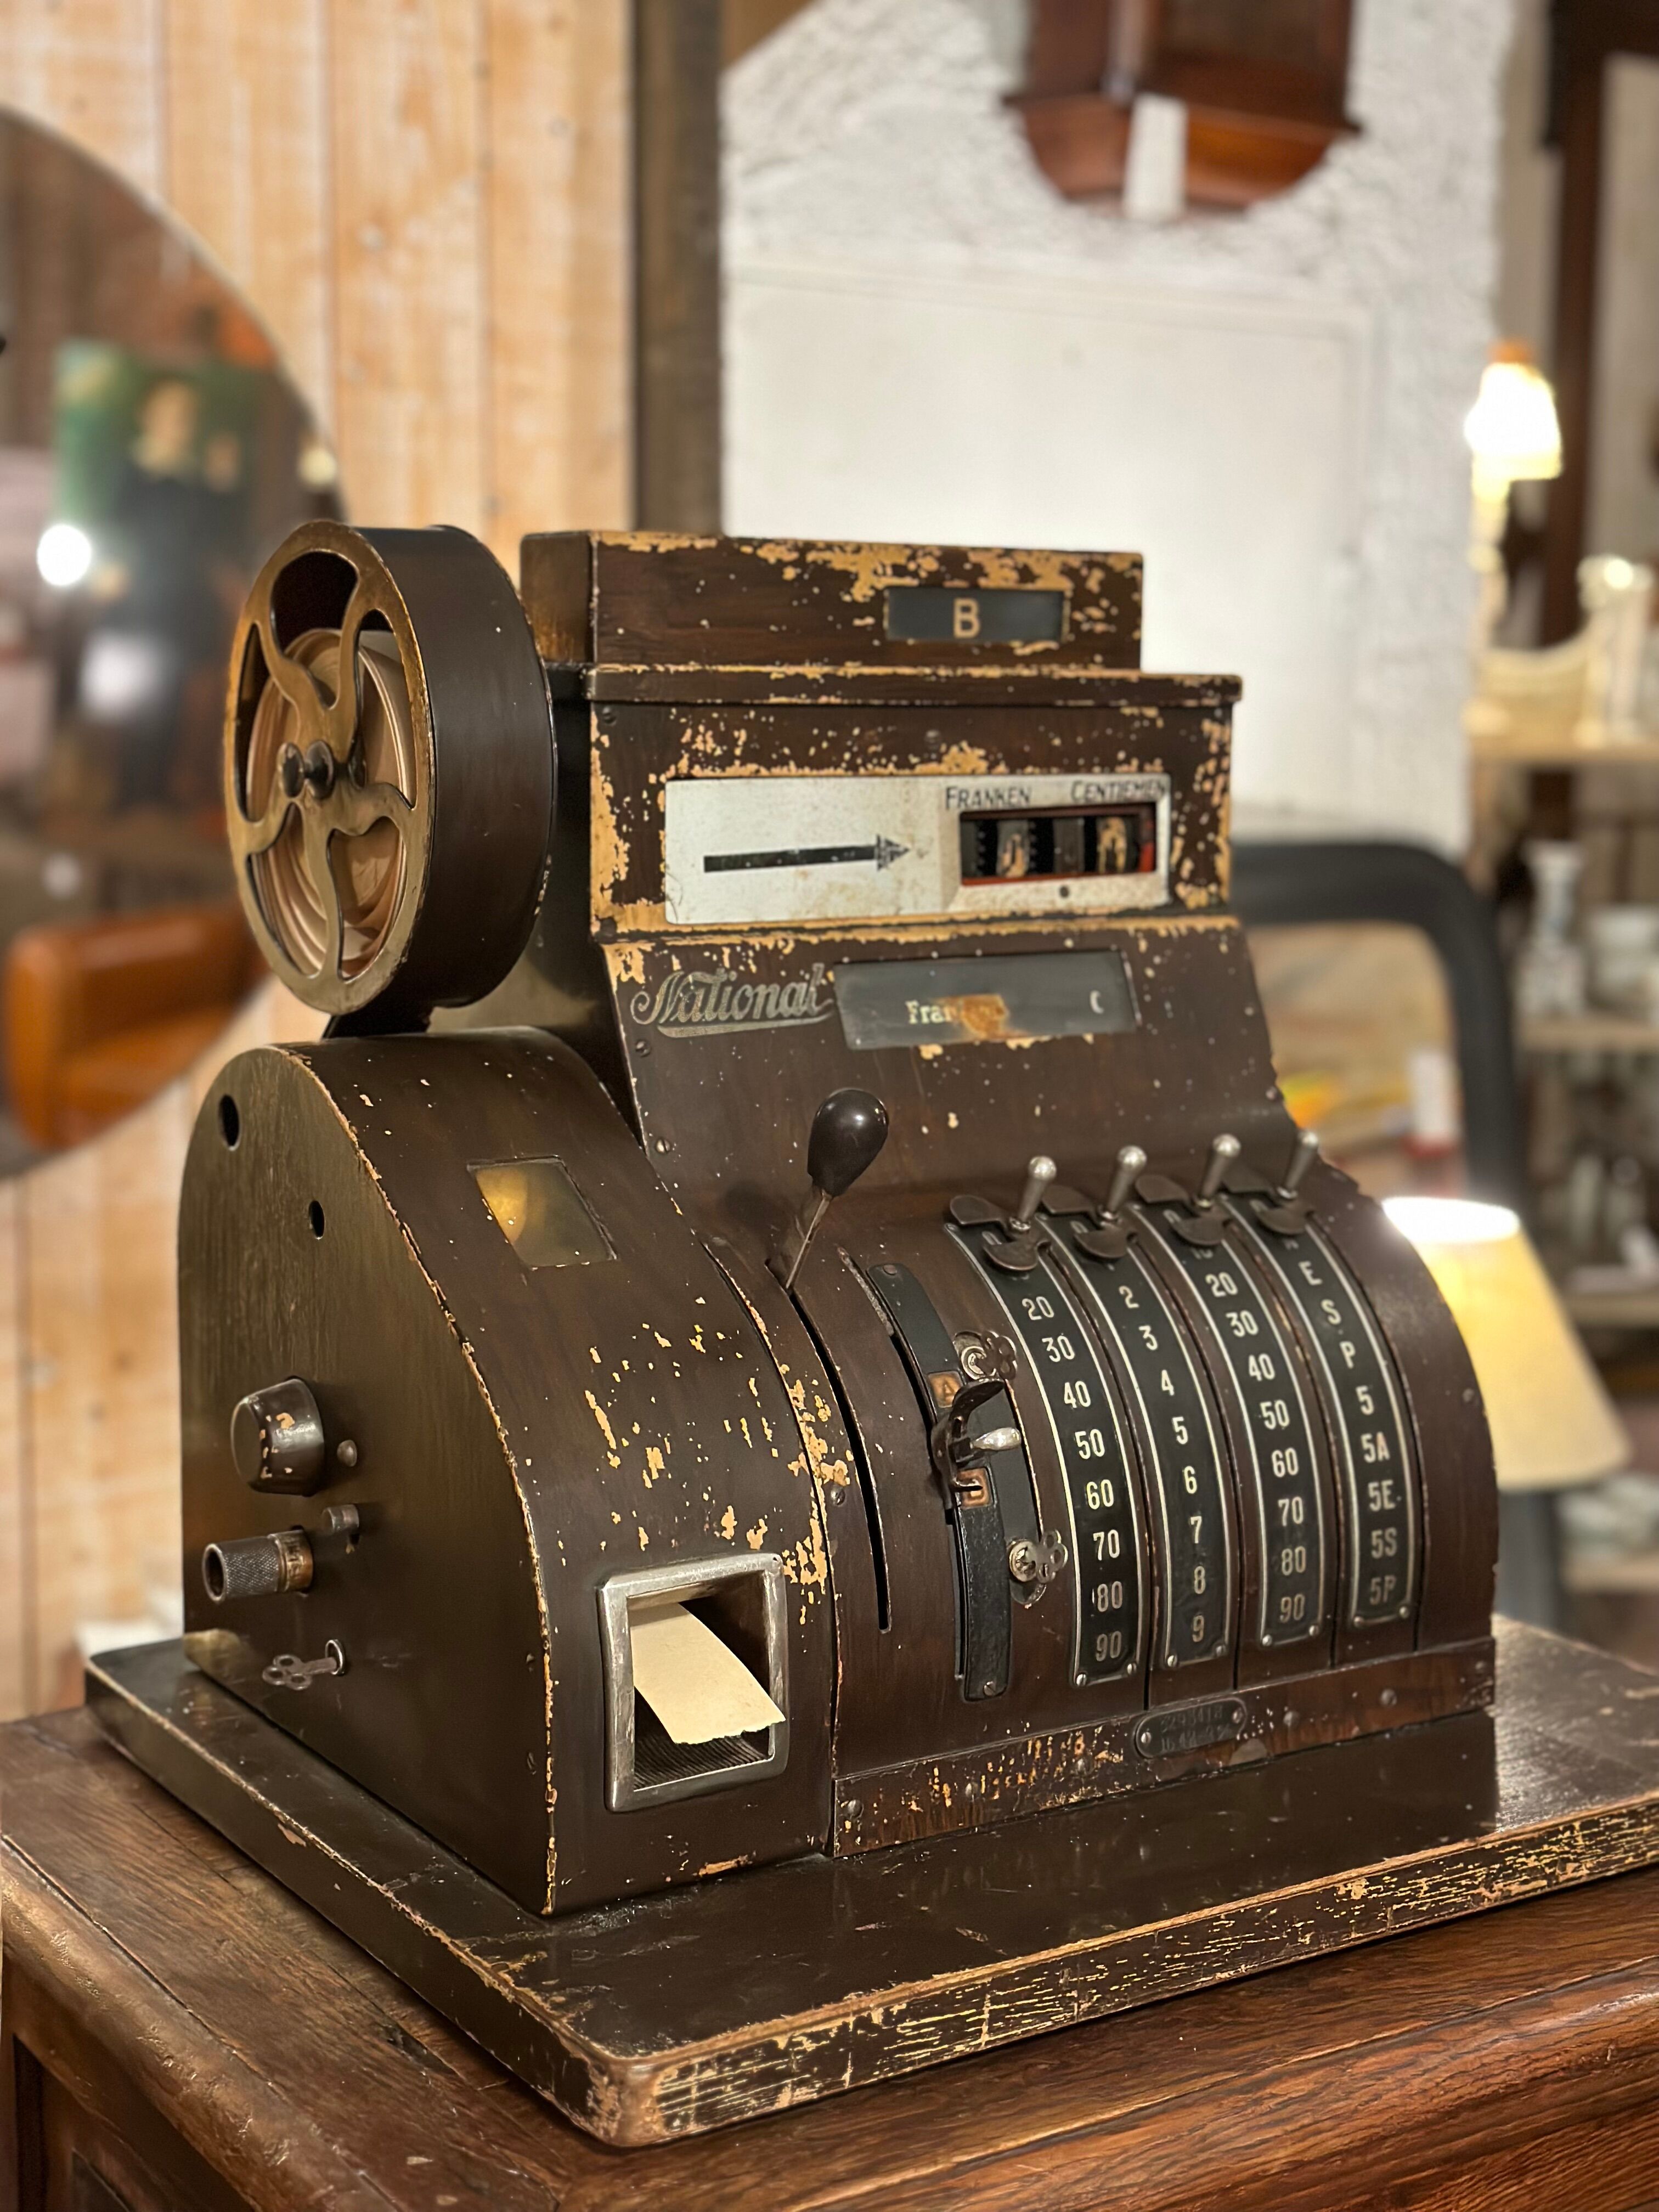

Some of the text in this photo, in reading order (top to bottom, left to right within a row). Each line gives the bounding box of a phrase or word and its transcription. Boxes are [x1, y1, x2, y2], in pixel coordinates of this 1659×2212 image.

[953, 598, 980, 639] B
[945, 785, 1031, 809] FRANKEN
[630, 963, 833, 1025] National
[1205, 1272, 1238, 1297] 20
[1299, 1261, 1322, 1285] E
[1022, 1296, 1054, 1321] 20
[1119, 1285, 1139, 1308] 2
[1226, 1310, 1259, 1338] 30
[1321, 1299, 1341, 1324] S
[1041, 1335, 1075, 1362] 30
[1138, 1325, 1158, 1351] 3
[1249, 1353, 1276, 1381] 40
[1340, 1341, 1356, 1368] P
[1064, 1380, 1091, 1408] 40
[1161, 1369, 1175, 1396] 4
[1356, 1385, 1374, 1415] 5
[1260, 1400, 1290, 1430] 50
[1075, 1429, 1105, 1459] 50
[1172, 1416, 1188, 1444] 5
[1271, 1447, 1299, 1477] 60
[1361, 1432, 1390, 1463] 5A
[1183, 1465, 1198, 1494] 6
[1086, 1479, 1114, 1510] 60
[1368, 1479, 1396, 1511] 5E
[1278, 1496, 1304, 1525] 70
[1190, 1515, 1202, 1544] 7
[1371, 1527, 1397, 1559] 5S
[1093, 1529, 1120, 1561] 70
[1281, 1545, 1306, 1576] 80
[1194, 1566, 1206, 1594] 8
[1369, 1575, 1397, 1605] 5P
[1097, 1581, 1123, 1612] 80
[1279, 1593, 1305, 1623] 90
[1192, 1615, 1205, 1643] 9
[1095, 1630, 1122, 1662] 90
